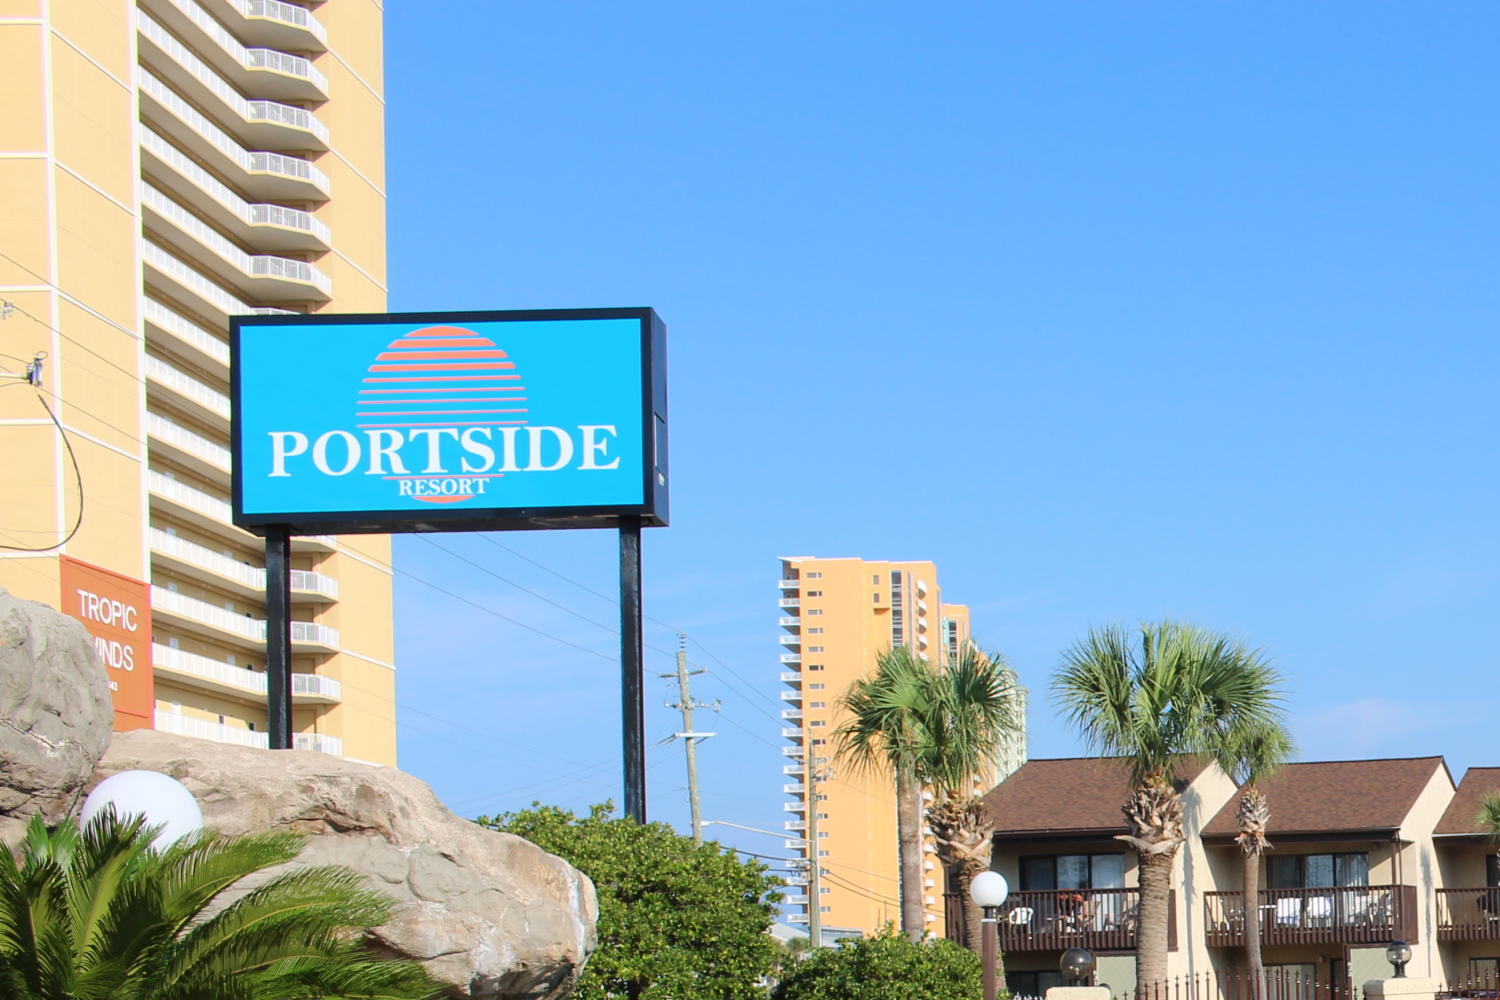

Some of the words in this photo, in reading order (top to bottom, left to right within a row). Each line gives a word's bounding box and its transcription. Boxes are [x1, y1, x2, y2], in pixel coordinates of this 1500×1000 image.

[267, 424, 621, 478] PORTSIDE
[399, 477, 490, 496] RESORT
[77, 589, 138, 632] TROPIC
[95, 637, 134, 672] INDS
